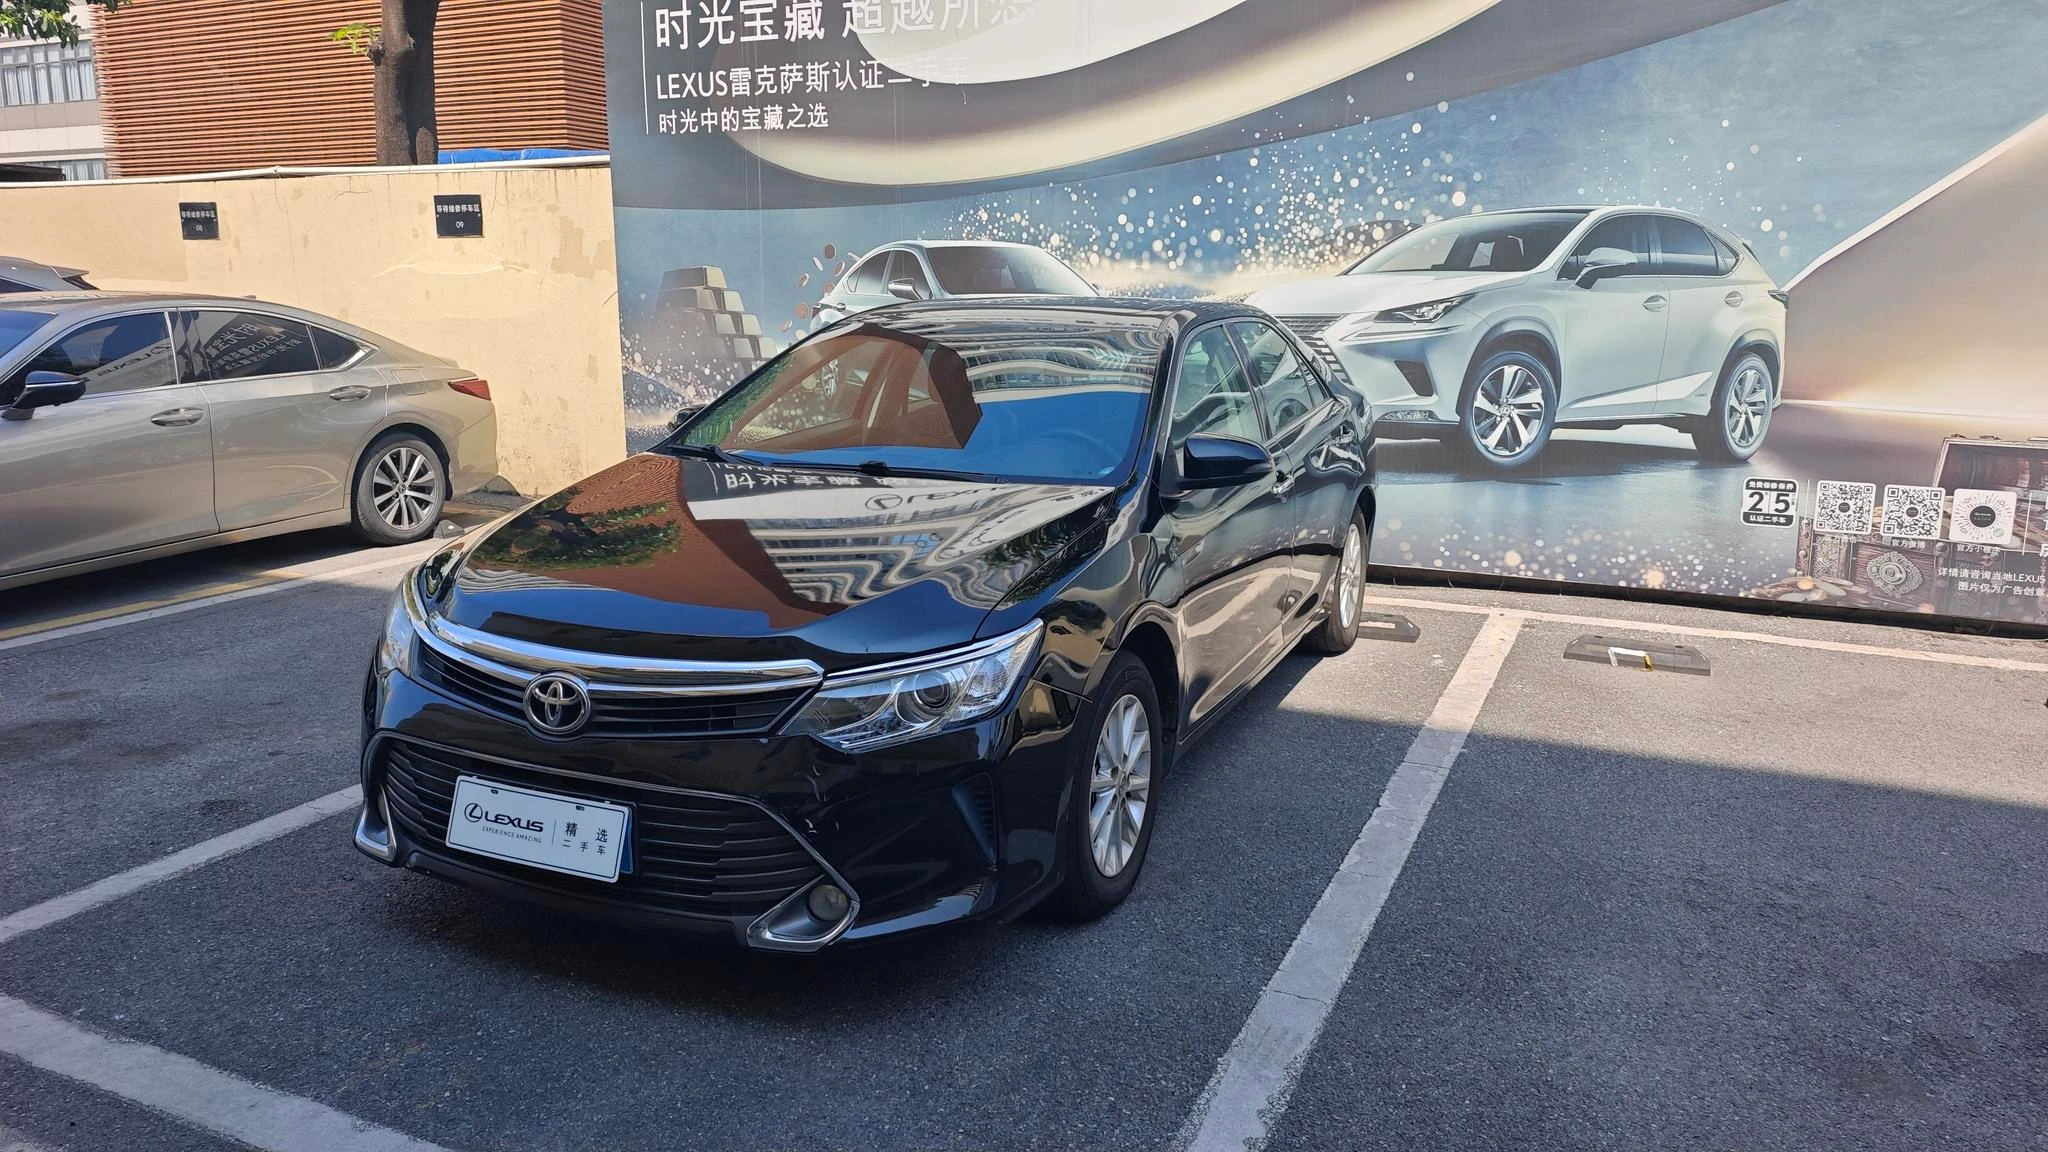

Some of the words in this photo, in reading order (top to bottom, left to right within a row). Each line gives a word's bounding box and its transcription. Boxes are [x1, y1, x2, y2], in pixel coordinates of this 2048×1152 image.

[658, 102, 829, 135] 时光中的宝藏之选
[455, 221, 464, 229] 09
[484, 810, 544, 833] LEXUS
